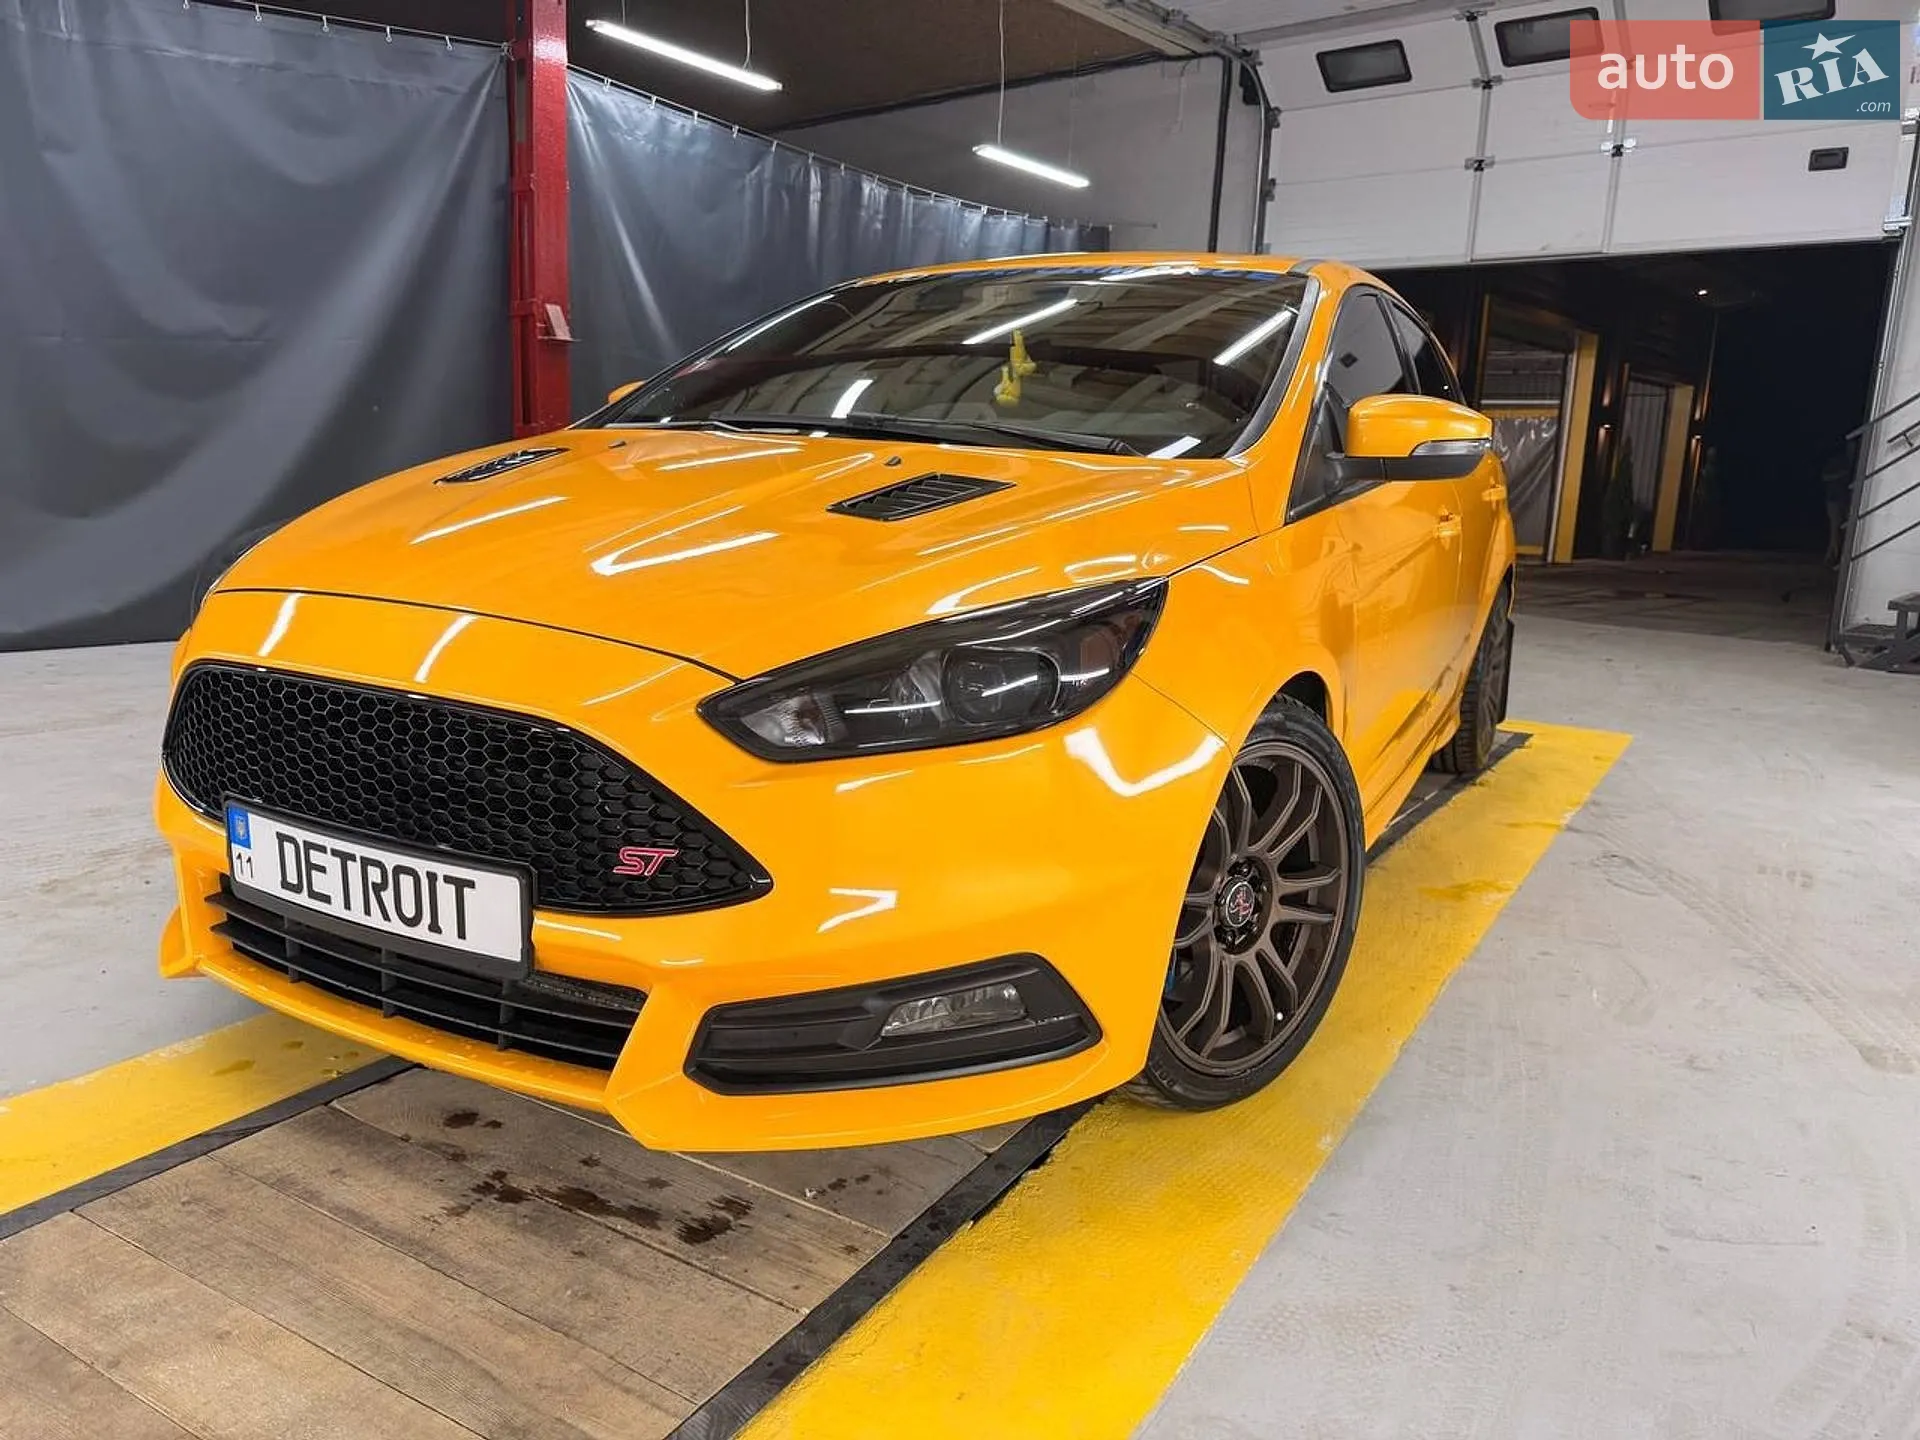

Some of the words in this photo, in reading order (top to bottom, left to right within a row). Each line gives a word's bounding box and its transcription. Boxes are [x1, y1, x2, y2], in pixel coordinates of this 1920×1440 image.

[236, 852, 254, 879] 11
[612, 846, 679, 876] ST
[276, 831, 476, 940] DETROIT
